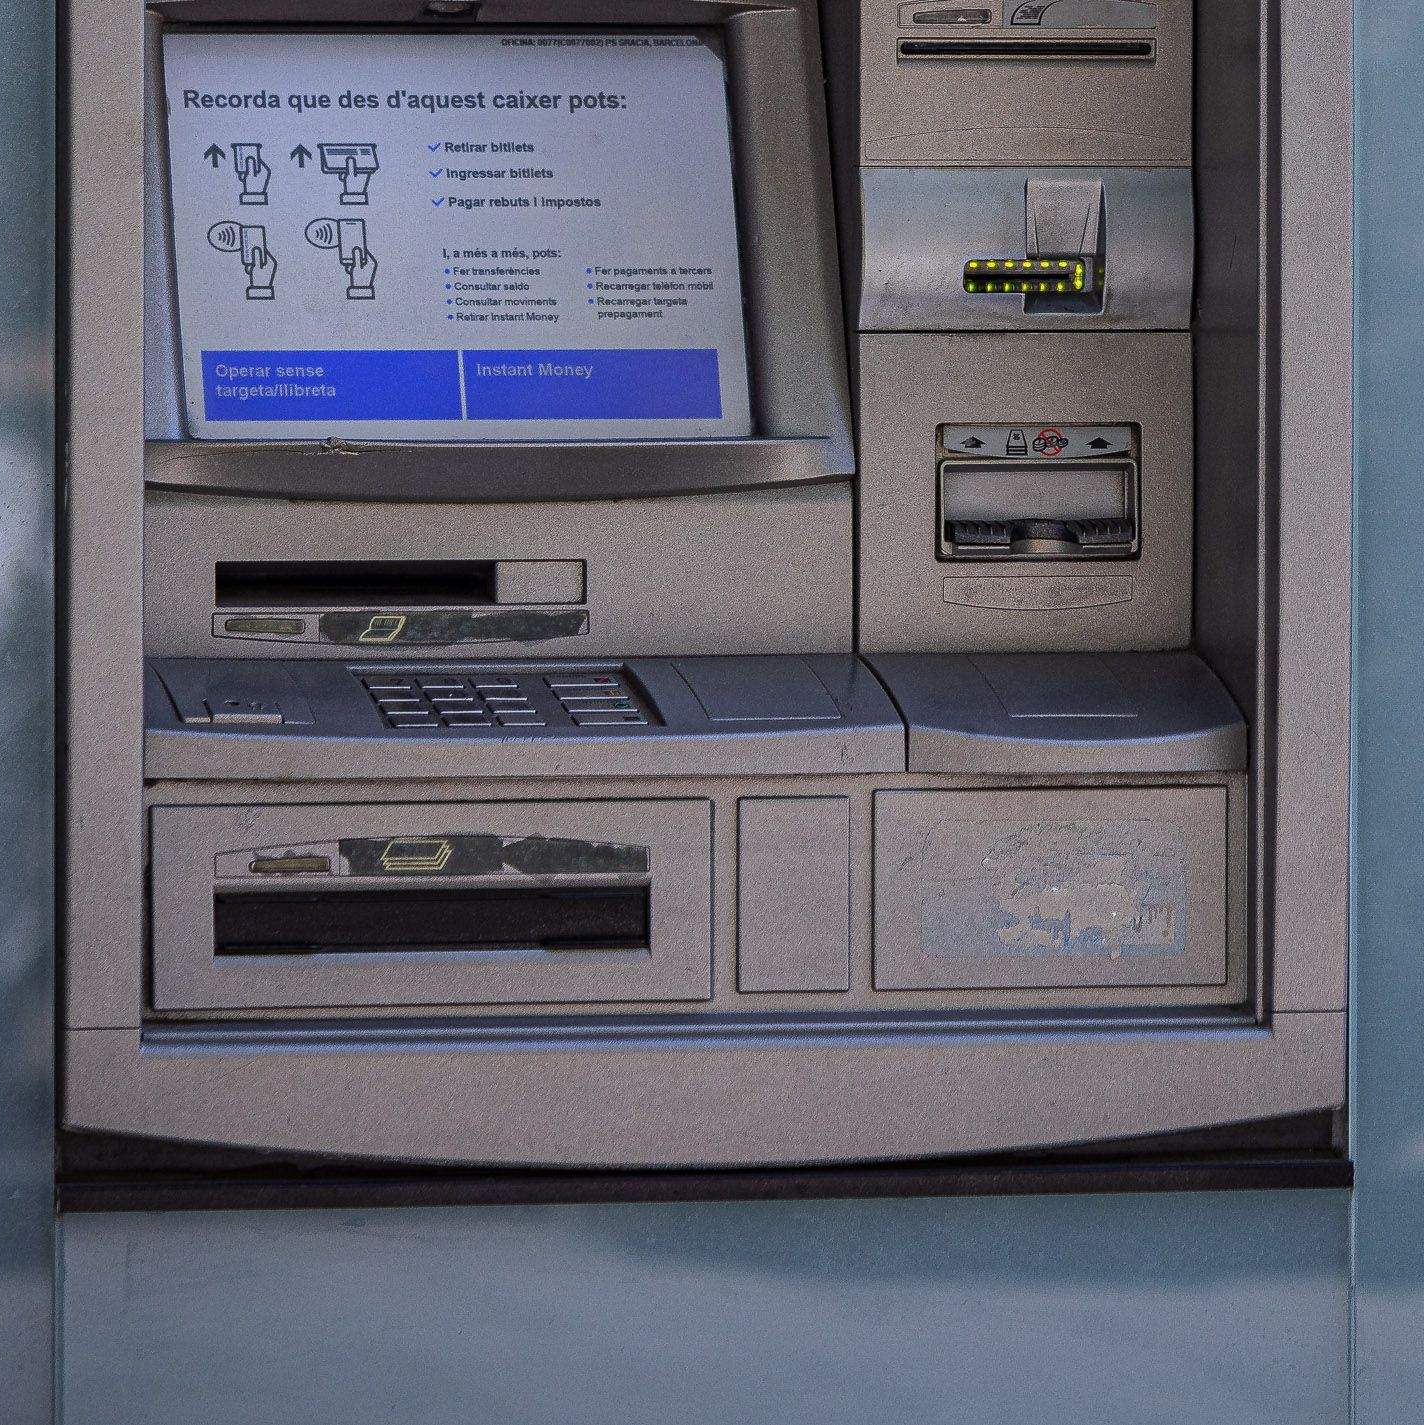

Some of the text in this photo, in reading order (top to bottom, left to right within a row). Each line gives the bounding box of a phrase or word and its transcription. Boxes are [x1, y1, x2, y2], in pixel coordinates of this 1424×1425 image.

[182, 89, 628, 114] Recorda que des d'aquest caixer pots:
[444, 142, 536, 153] Retirar bitllets
[446, 168, 555, 181] Ingressar bitllets
[448, 196, 486, 209] Pagar
[489, 196, 530, 208] rebuts
[541, 196, 602, 210] impostos
[452, 250, 460, 258] a
[463, 247, 488, 258] més
[491, 250, 498, 258] a
[501, 247, 530, 260] més,
[532, 248, 562, 260] pots:
[452, 266, 541, 276] Fer transferències
[594, 266, 611, 275] Fer
[613, 267, 668, 277] pagaments
[679, 266, 713, 275] tercers
[454, 282, 530, 291] Consultar saldo
[595, 281, 652, 292] Recarregar
[455, 297, 557, 307] Consultar moviments
[597, 297, 688, 308] Recarregar targeta
[456, 312, 559, 324] Retirar Instant Money
[597, 309, 664, 320] prepagament
[215, 363, 325, 381] Operar sense
[476, 362, 594, 379] Instant Money
[215, 382, 337, 400] targeta/llibreta
